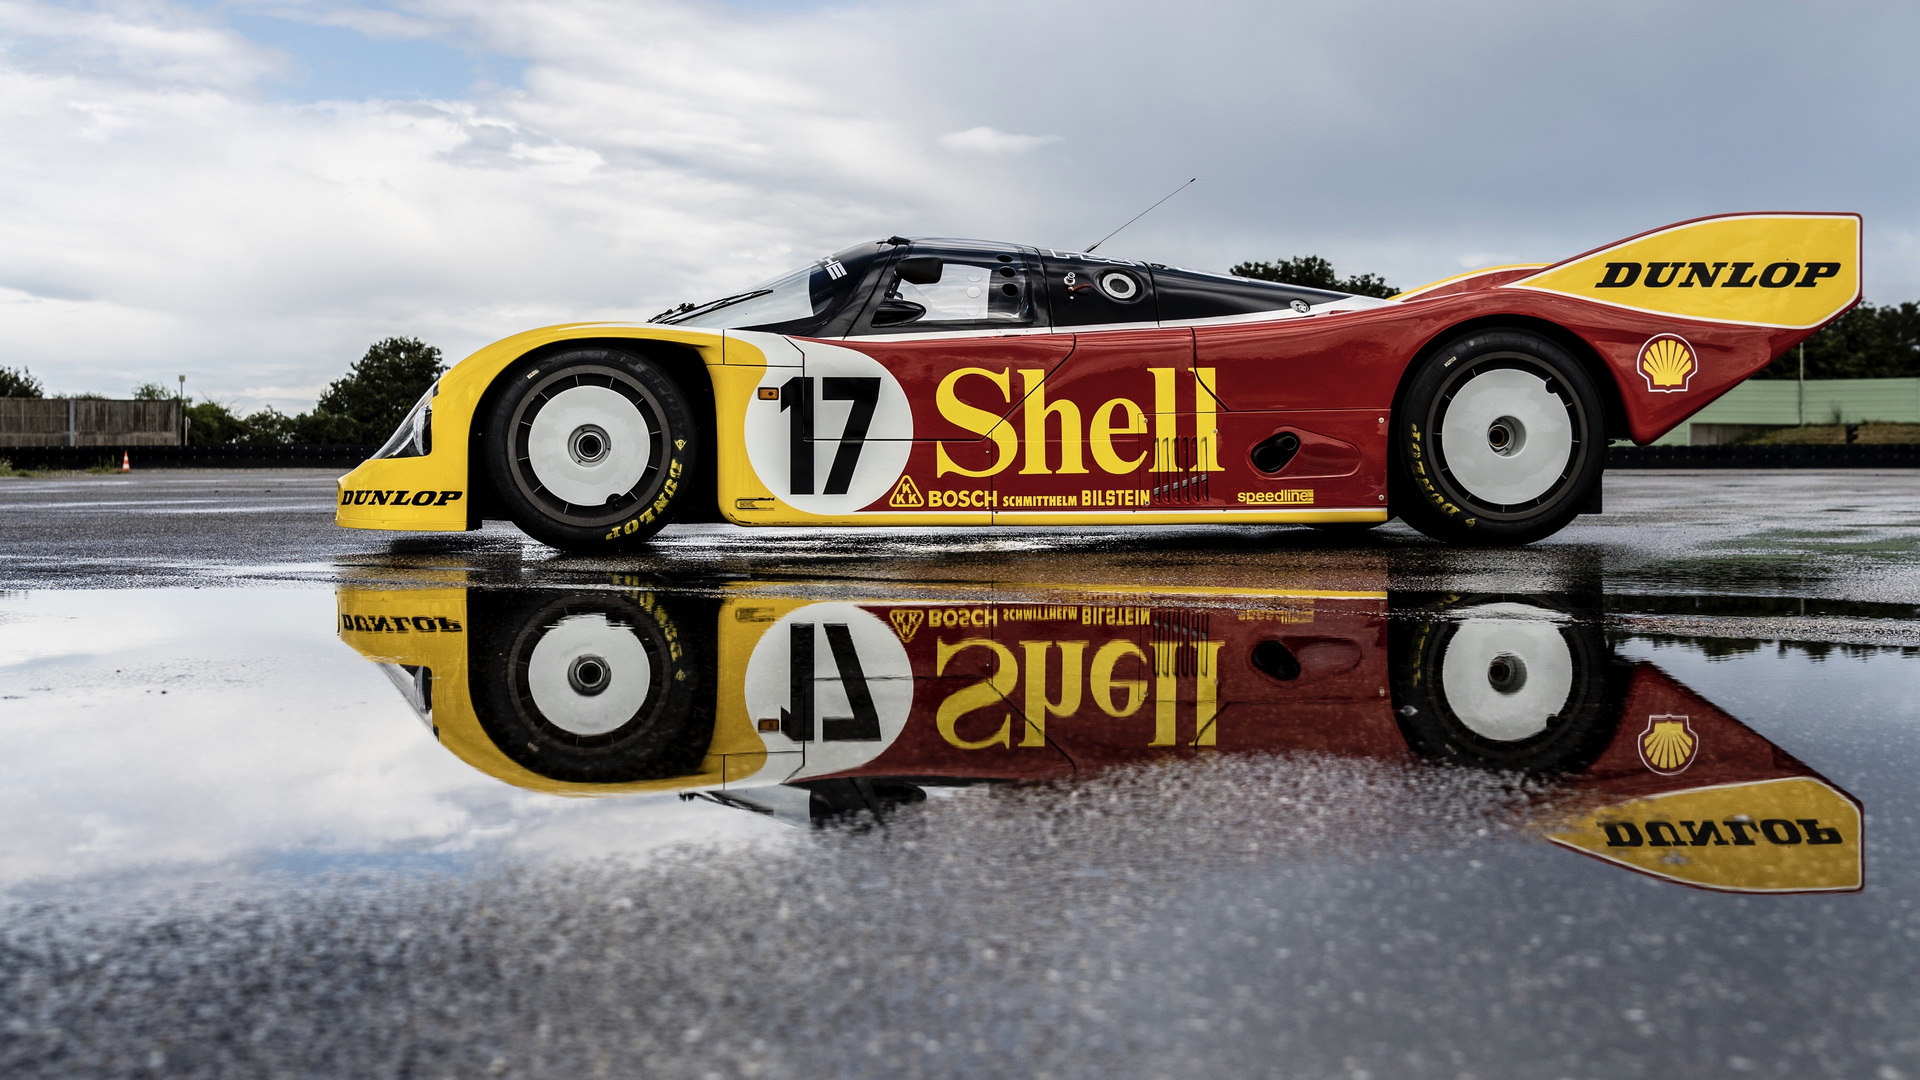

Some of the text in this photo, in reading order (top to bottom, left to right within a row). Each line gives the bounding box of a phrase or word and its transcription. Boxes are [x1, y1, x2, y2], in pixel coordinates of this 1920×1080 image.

[1595, 261, 1842, 288] DUNLOP
[936, 367, 1225, 478] Shell
[779, 376, 881, 496] 17
[341, 490, 463, 506] DUNLOP
[605, 458, 683, 541] DUNLOP
[928, 490, 998, 508] BOSCH
[1003, 495, 1078, 507] SCHMITTHELM
[1081, 490, 1150, 507] BILSTEIN
[1237, 489, 1314, 505] speedline
